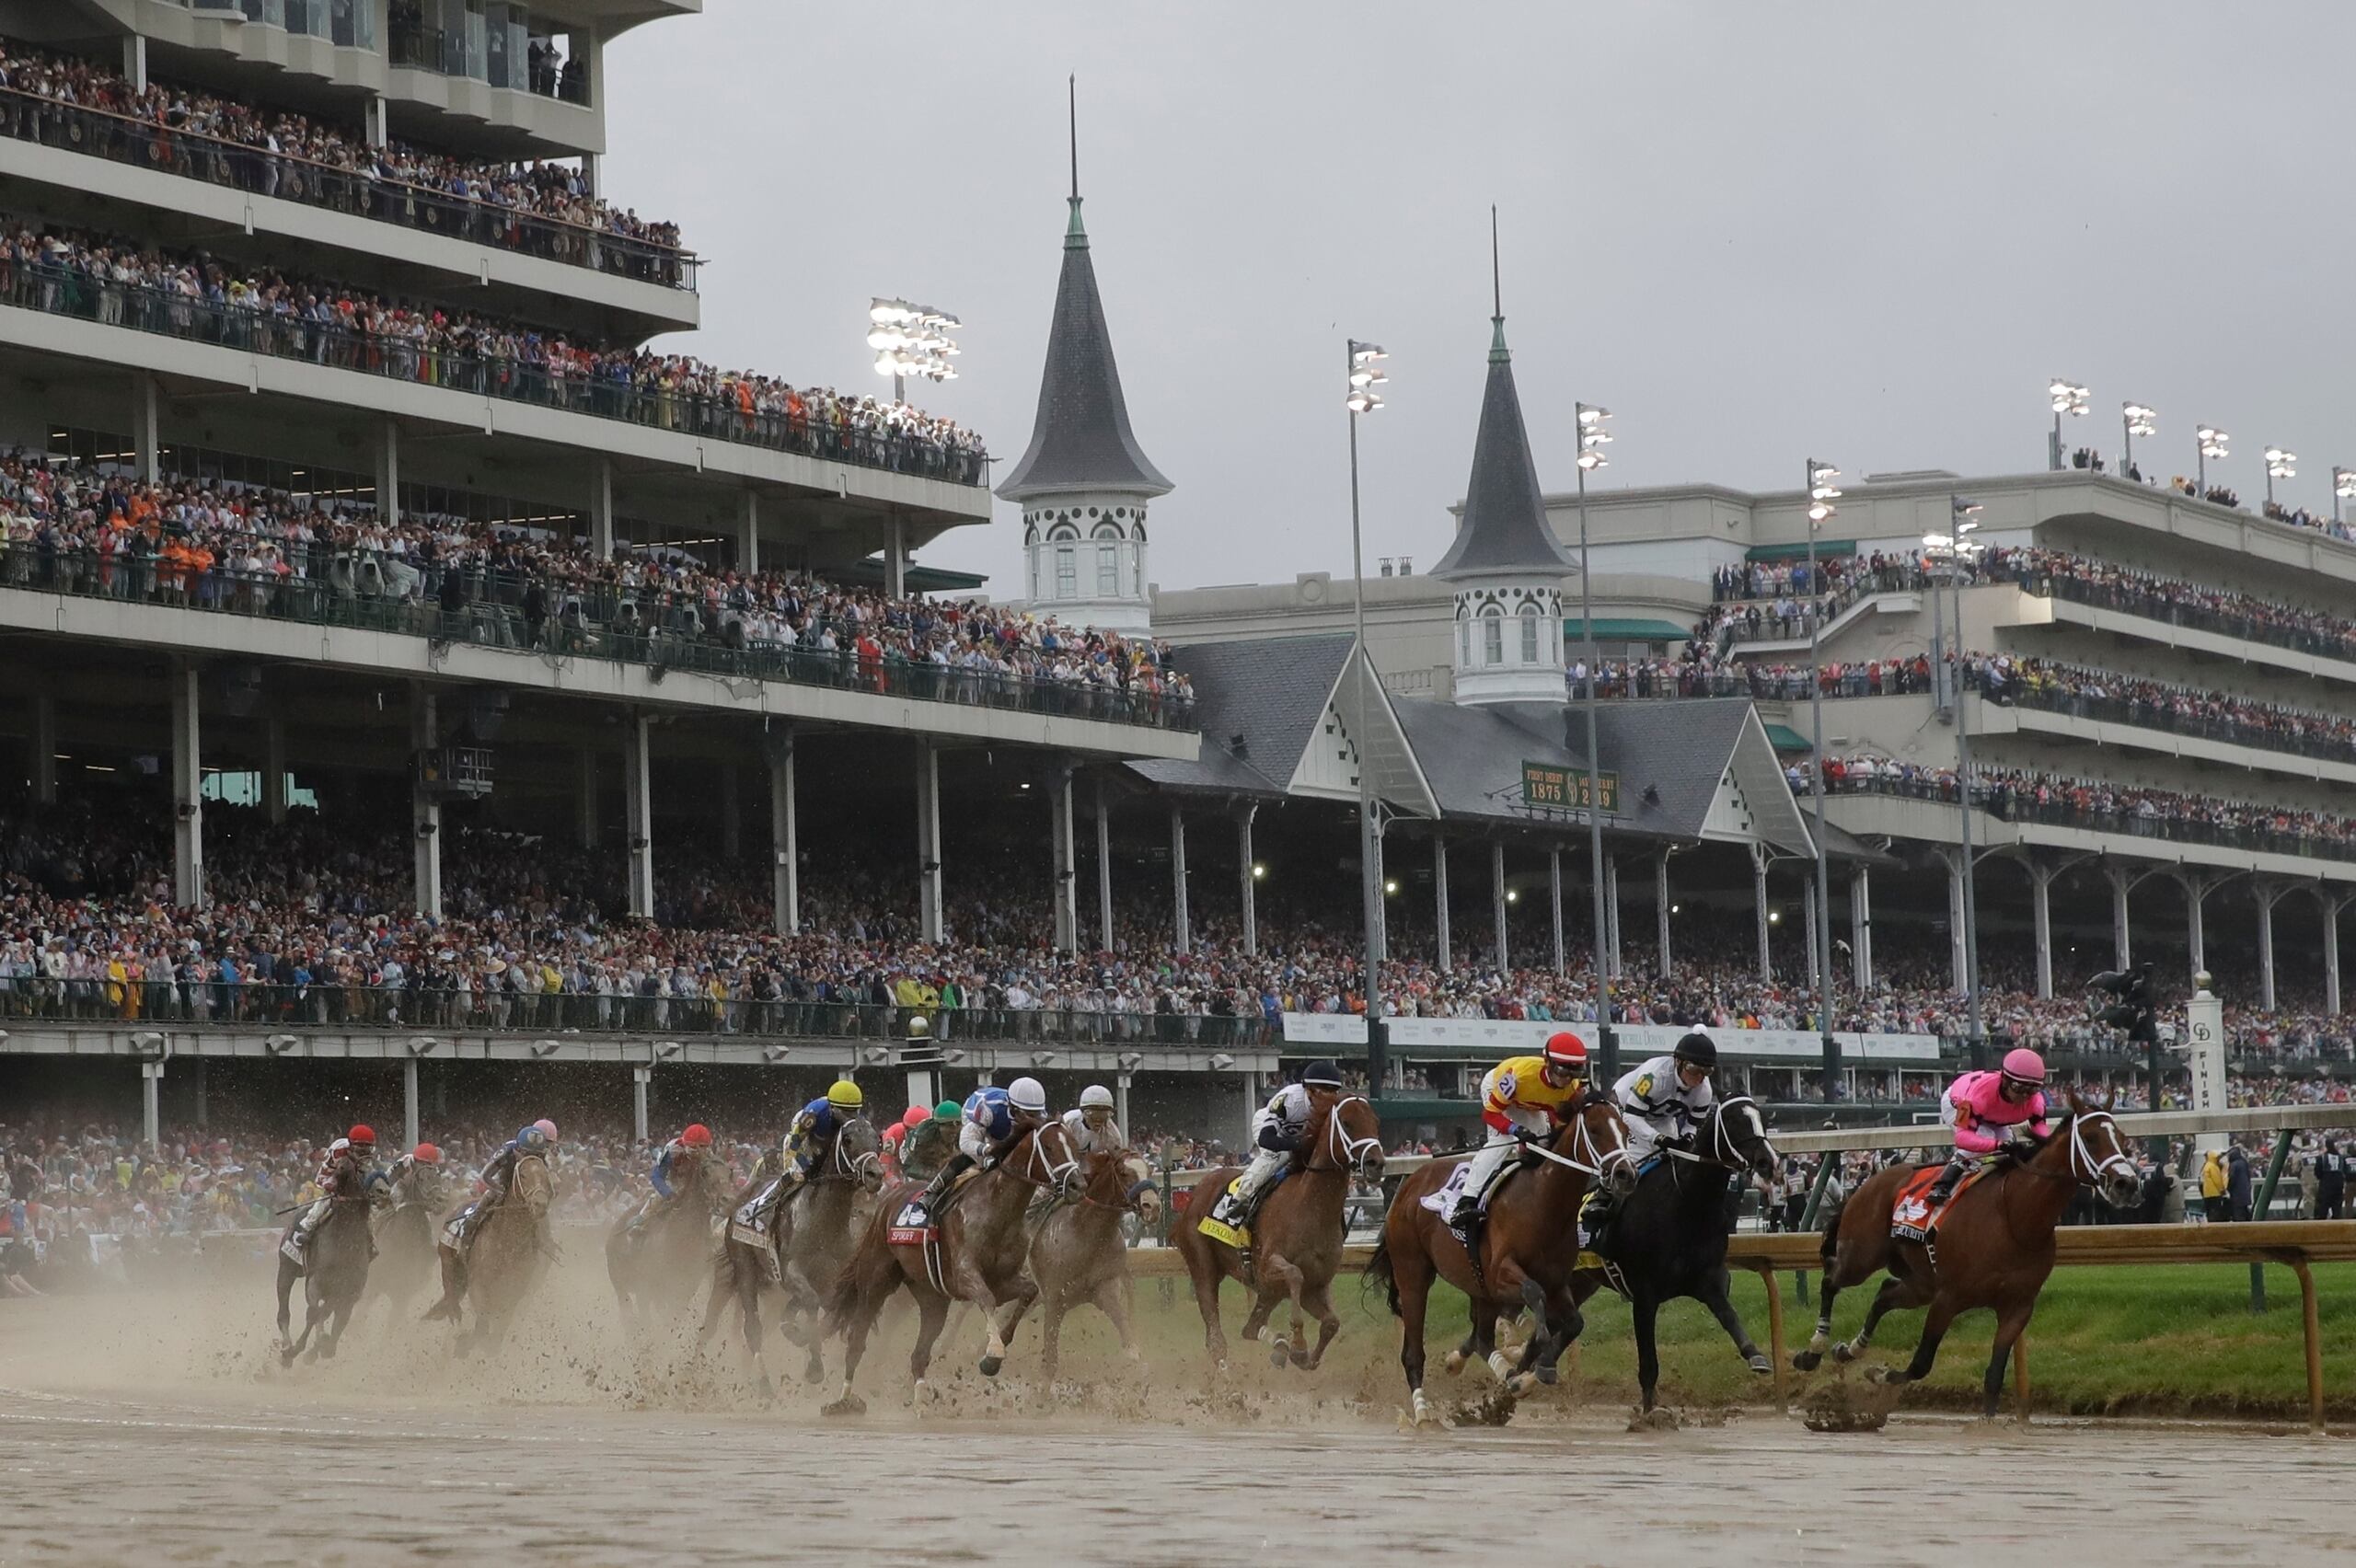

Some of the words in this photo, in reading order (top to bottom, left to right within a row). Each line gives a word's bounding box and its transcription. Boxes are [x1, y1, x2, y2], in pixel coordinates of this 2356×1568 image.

[1531, 782, 1561, 801] 1875
[1598, 778, 1614, 790] ERBY
[1582, 789, 1610, 807] 219
[1496, 1077, 1512, 1095] 21
[1634, 1074, 1651, 1096] 18
[2200, 1051, 2210, 1109] FINISH
[1207, 1221, 1235, 1241] VEKOM
